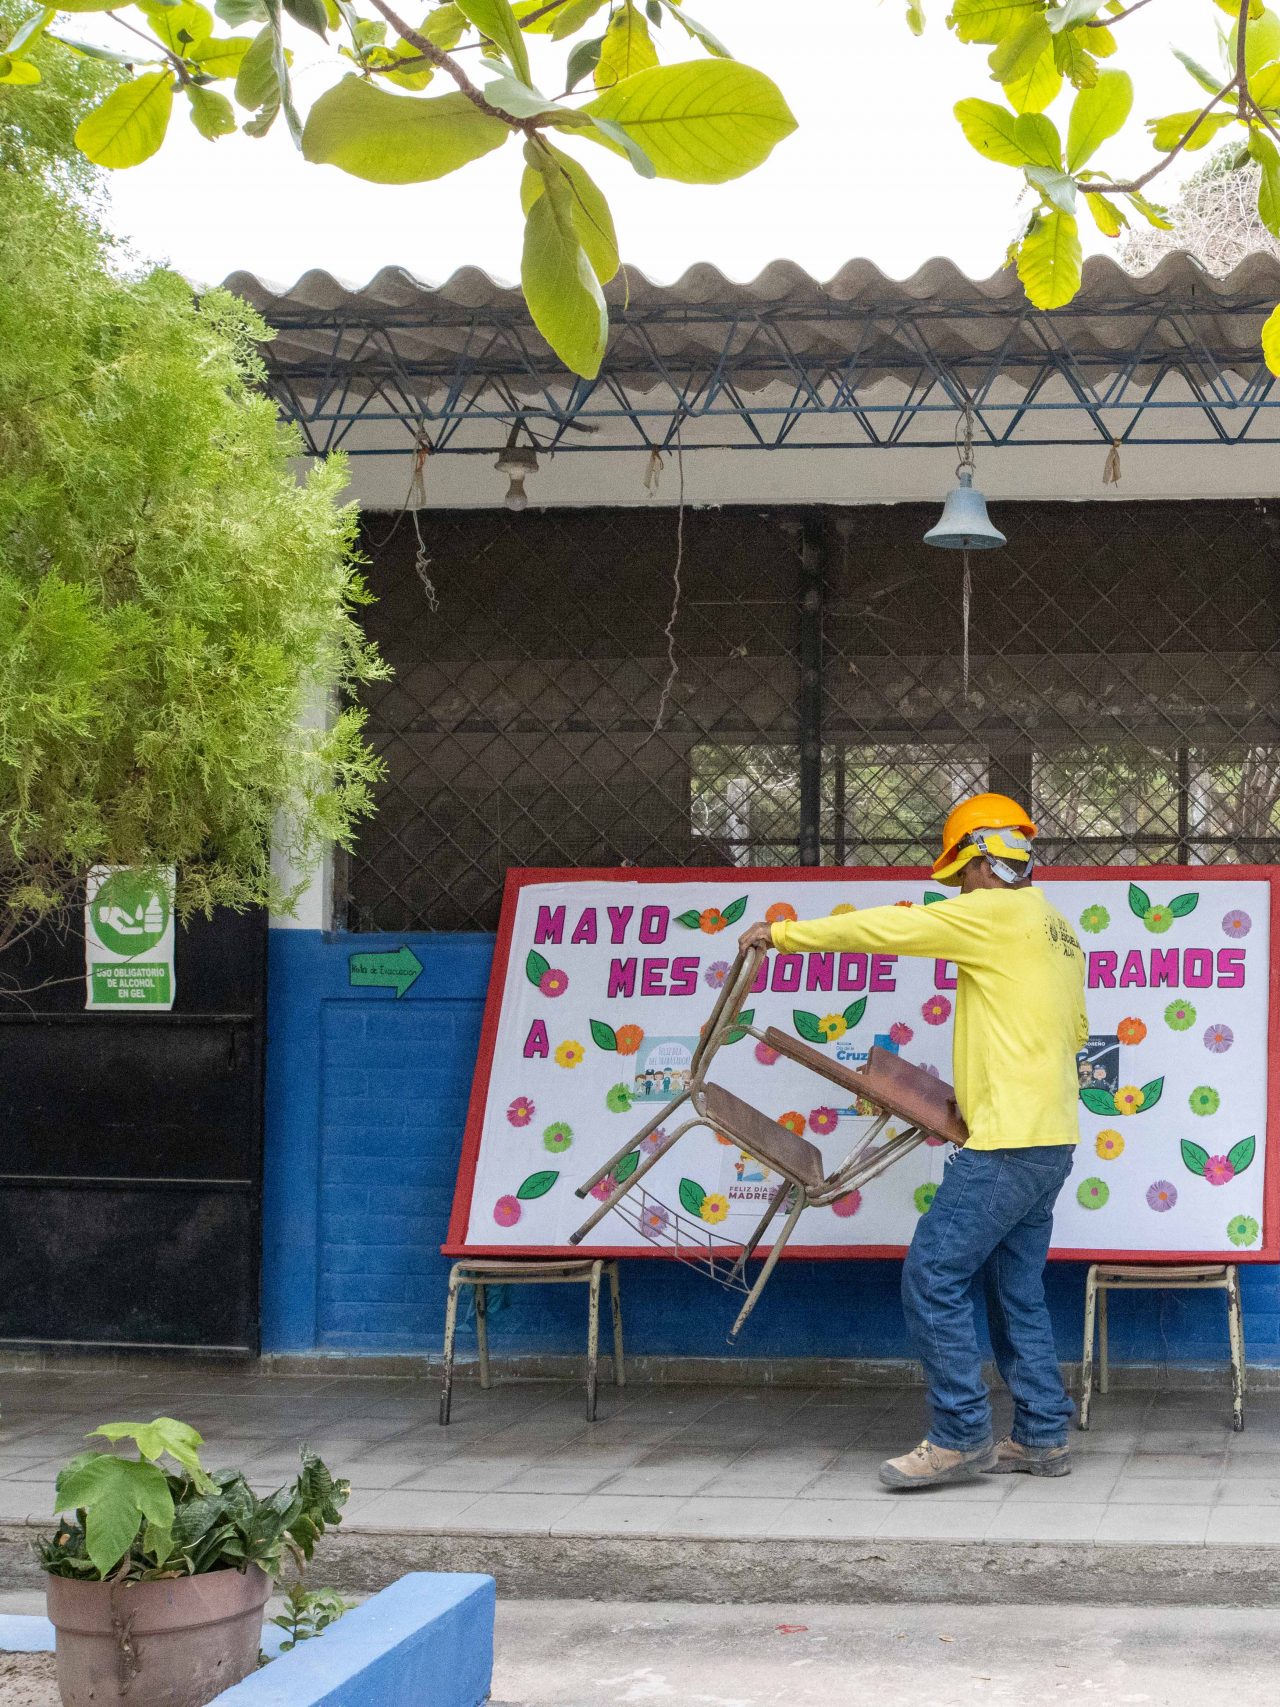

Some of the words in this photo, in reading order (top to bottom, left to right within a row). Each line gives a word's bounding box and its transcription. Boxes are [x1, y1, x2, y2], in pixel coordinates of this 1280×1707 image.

[534, 905, 670, 945] MAYO
[96, 968, 112, 978] USO
[113, 967, 165, 978] OBLIGATORIO
[607, 956, 700, 998] MES
[107, 978, 118, 988] DE
[119, 978, 155, 988] ALCOHOL
[118, 988, 129, 998] EN
[130, 988, 146, 998] GEL
[522, 1019, 549, 1058] A
[836, 1051, 868, 1061] Cruz
